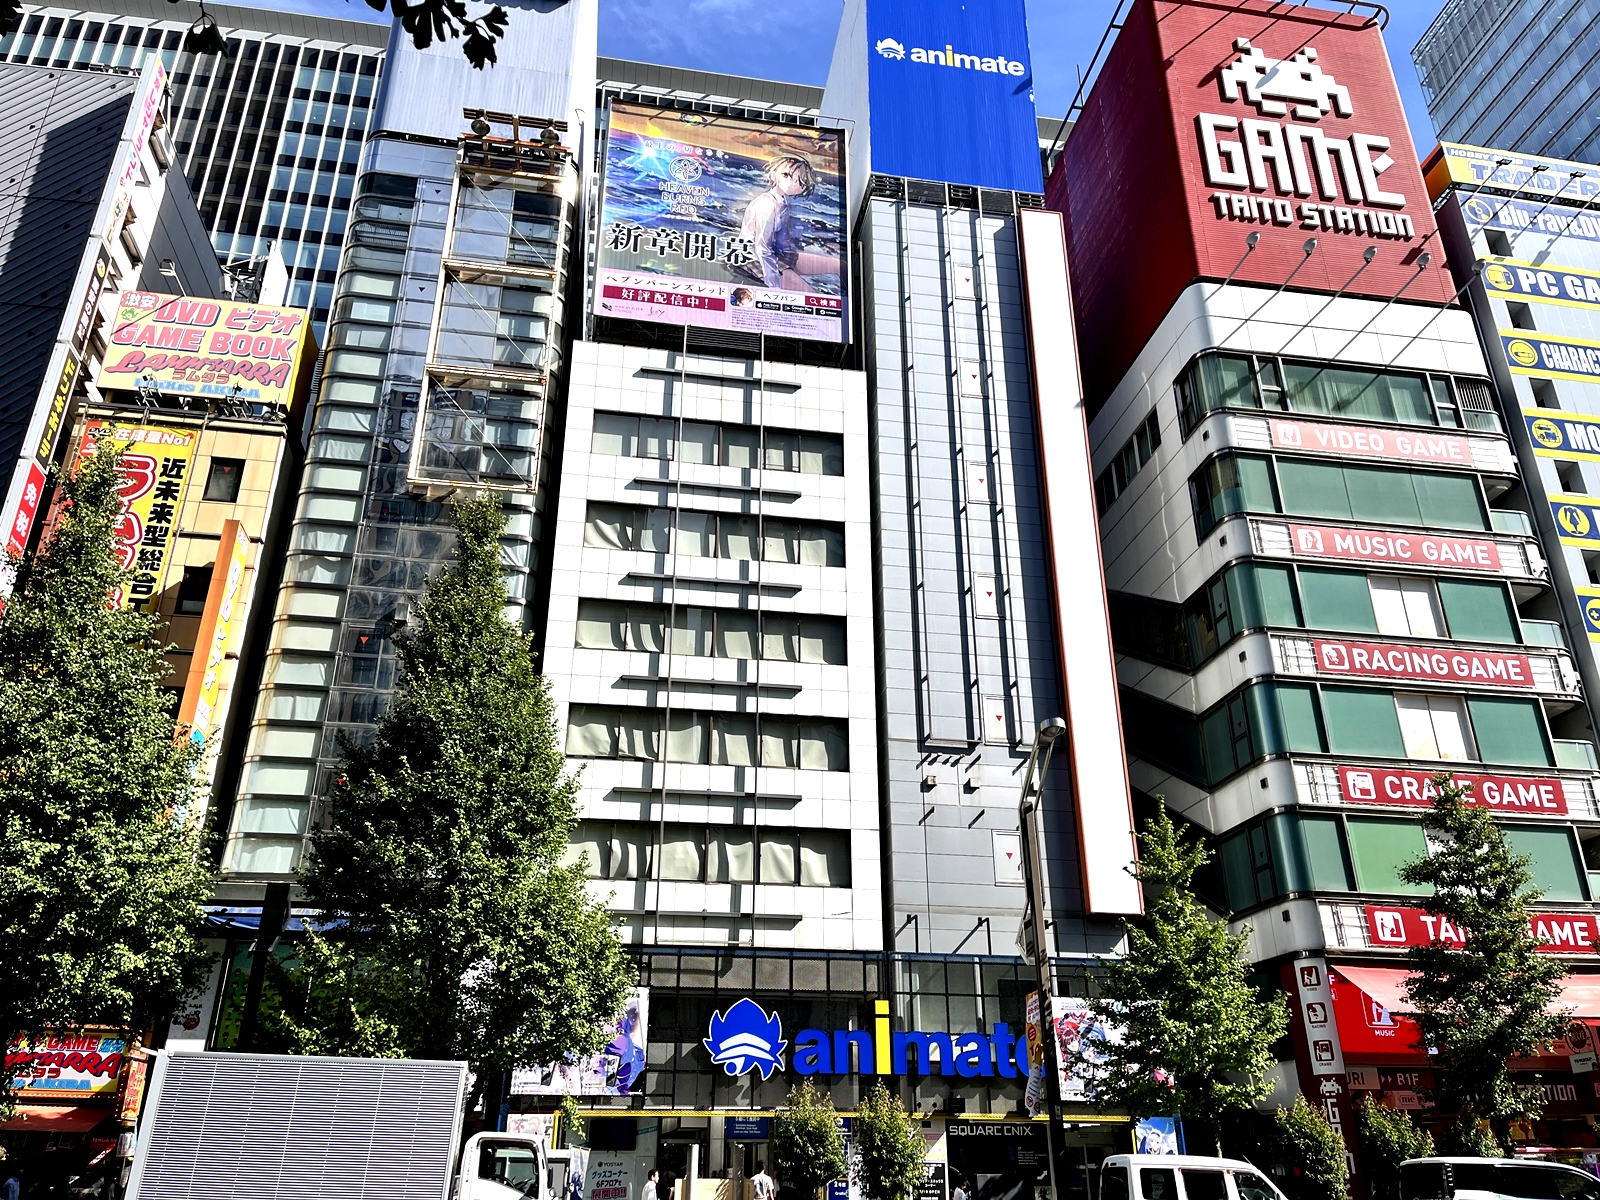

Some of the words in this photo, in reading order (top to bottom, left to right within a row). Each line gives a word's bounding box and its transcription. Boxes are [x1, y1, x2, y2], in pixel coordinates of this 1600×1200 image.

[910, 44, 1025, 76] animate
[1199, 112, 1407, 206] GAME
[1450, 148, 1489, 160] HOBBY
[1492, 154, 1524, 165] SP
[659, 182, 710, 196] HEAVEN
[662, 192, 707, 206] BURNS
[670, 203, 697, 215] RED
[1213, 192, 1294, 223] TAITO
[1300, 202, 1416, 237] STATION
[606, 222, 755, 266] 新章開幕
[606, 274, 726, 296] ヘブンバーンズレッド
[1516, 268, 1560, 297] PC
[125, 293, 156, 309] 激安
[819, 298, 838, 307] 検索
[153, 298, 221, 328] DVD
[225, 306, 303, 336] ビデオ
[111, 322, 205, 353] GAME
[208, 331, 297, 362] BOOK
[172, 368, 230, 385] ラムタラ
[1314, 428, 1385, 451] VIDEO
[1396, 434, 1464, 460] GAME
[16, 481, 38, 538] 免税
[1333, 532, 1412, 558] MUSIC
[1422, 540, 1492, 566] GAME
[1353, 647, 1449, 675] RACING
[1452, 654, 1525, 681] GAME
[1482, 780, 1558, 808] GAME
[1525, 919, 1590, 946] AME
[47, 1033, 102, 1051] GAME
[1374, 1029, 1396, 1037] MUSIC
[1397, 1073, 1419, 1086] B1F
[1401, 1095, 1416, 1103] me
[949, 1125, 1002, 1137] SQUARE
[1004, 1125, 1033, 1137] ENIX
[592, 1169, 629, 1180] グッズコーナー
